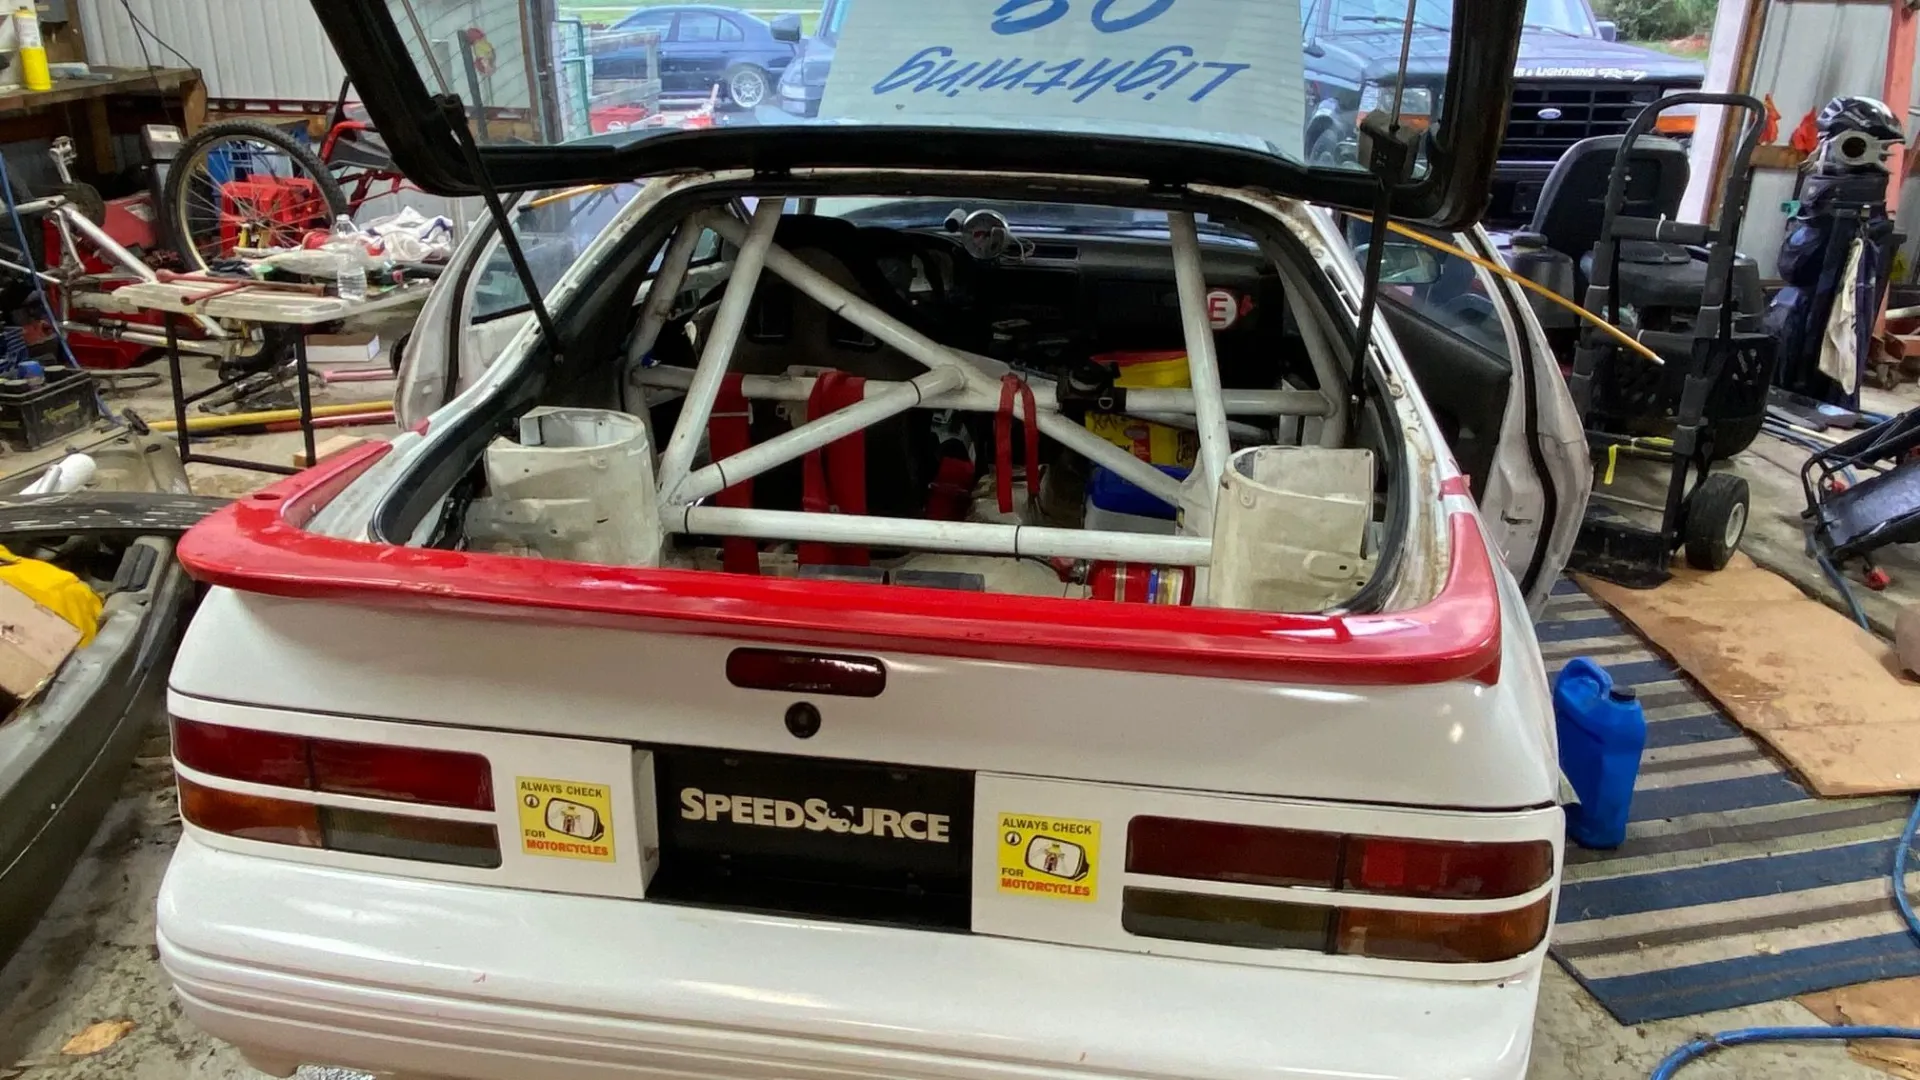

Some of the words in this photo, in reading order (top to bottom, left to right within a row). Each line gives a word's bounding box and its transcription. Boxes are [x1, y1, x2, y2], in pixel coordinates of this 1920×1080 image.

[871, 45, 1251, 103] Lightning
[1535, 66, 1595, 78] LIGHTNING
[1209, 297, 1228, 321] E
[520, 781, 563, 794] ALWAYS
[566, 785, 603, 798] CHECK
[525, 828, 546, 839] FOR
[1002, 818, 1049, 831] ALWAYS
[1052, 822, 1092, 835] CHECK
[526, 839, 609, 856] MOTORCYCLES
[1001, 867, 1024, 877] FOR
[1001, 877, 1090, 896] MOTORCYCLES
